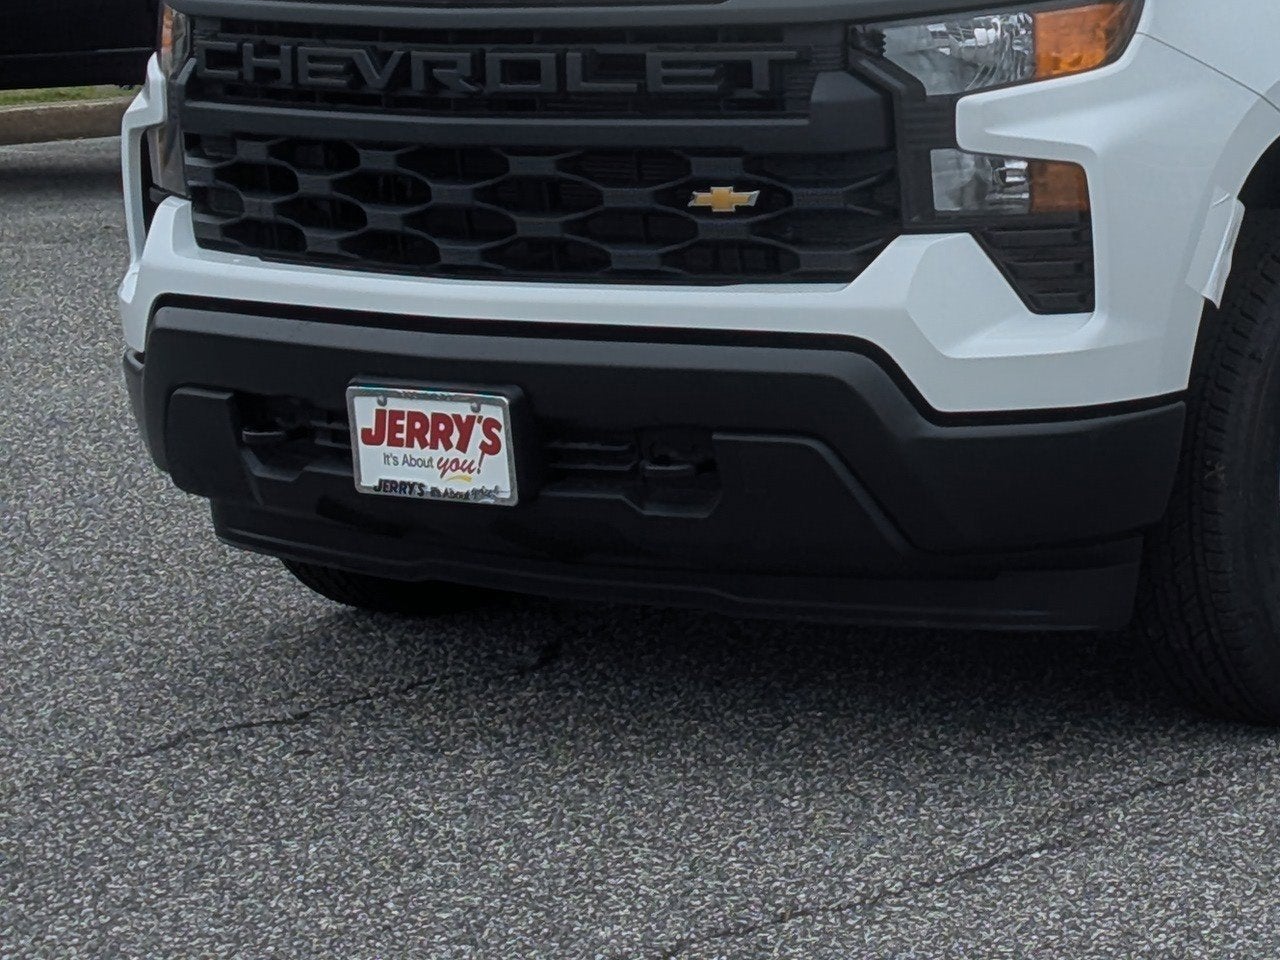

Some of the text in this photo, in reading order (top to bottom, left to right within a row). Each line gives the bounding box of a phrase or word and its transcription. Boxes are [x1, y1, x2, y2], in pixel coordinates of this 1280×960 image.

[199, 41, 797, 95] CHEVROLET
[360, 408, 503, 456] JERRY'S
[383, 452, 485, 479] It's About you!
[373, 478, 426, 498] JERRY'S
